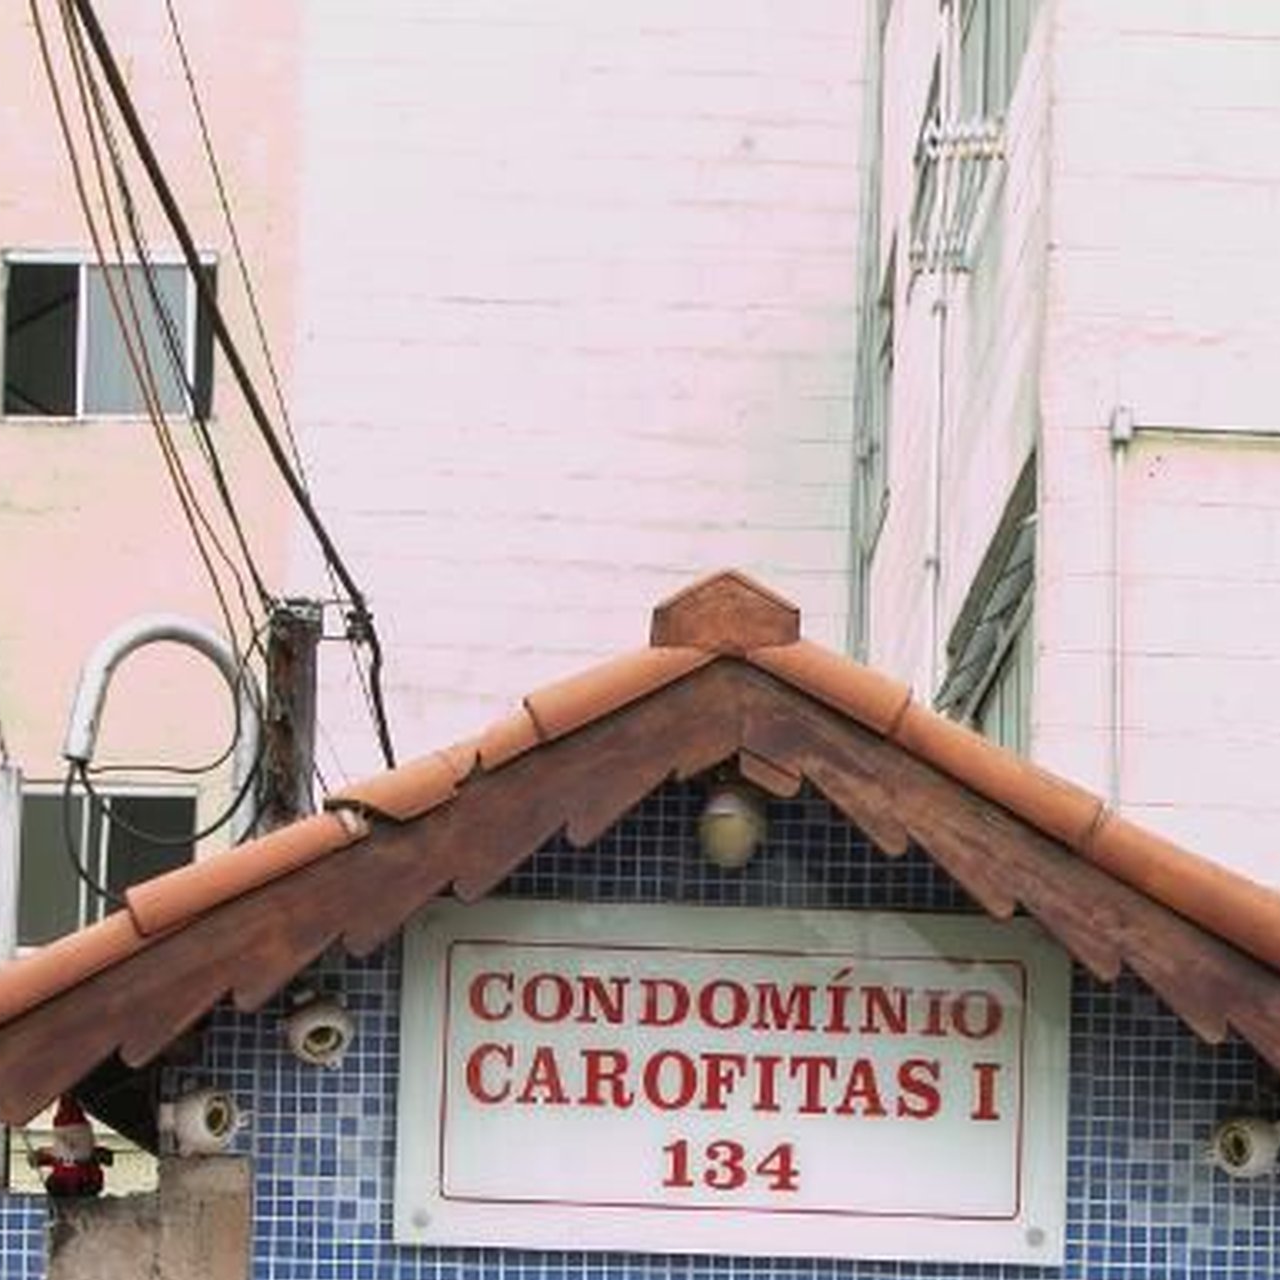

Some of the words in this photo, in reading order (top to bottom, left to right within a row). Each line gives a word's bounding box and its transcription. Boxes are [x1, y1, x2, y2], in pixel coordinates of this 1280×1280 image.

[468, 966, 1003, 1038] CONDOMÍNIO
[465, 1043, 942, 1119] CAROFITAS
[970, 1062, 1001, 1121] I
[661, 1139, 801, 1192] 134
